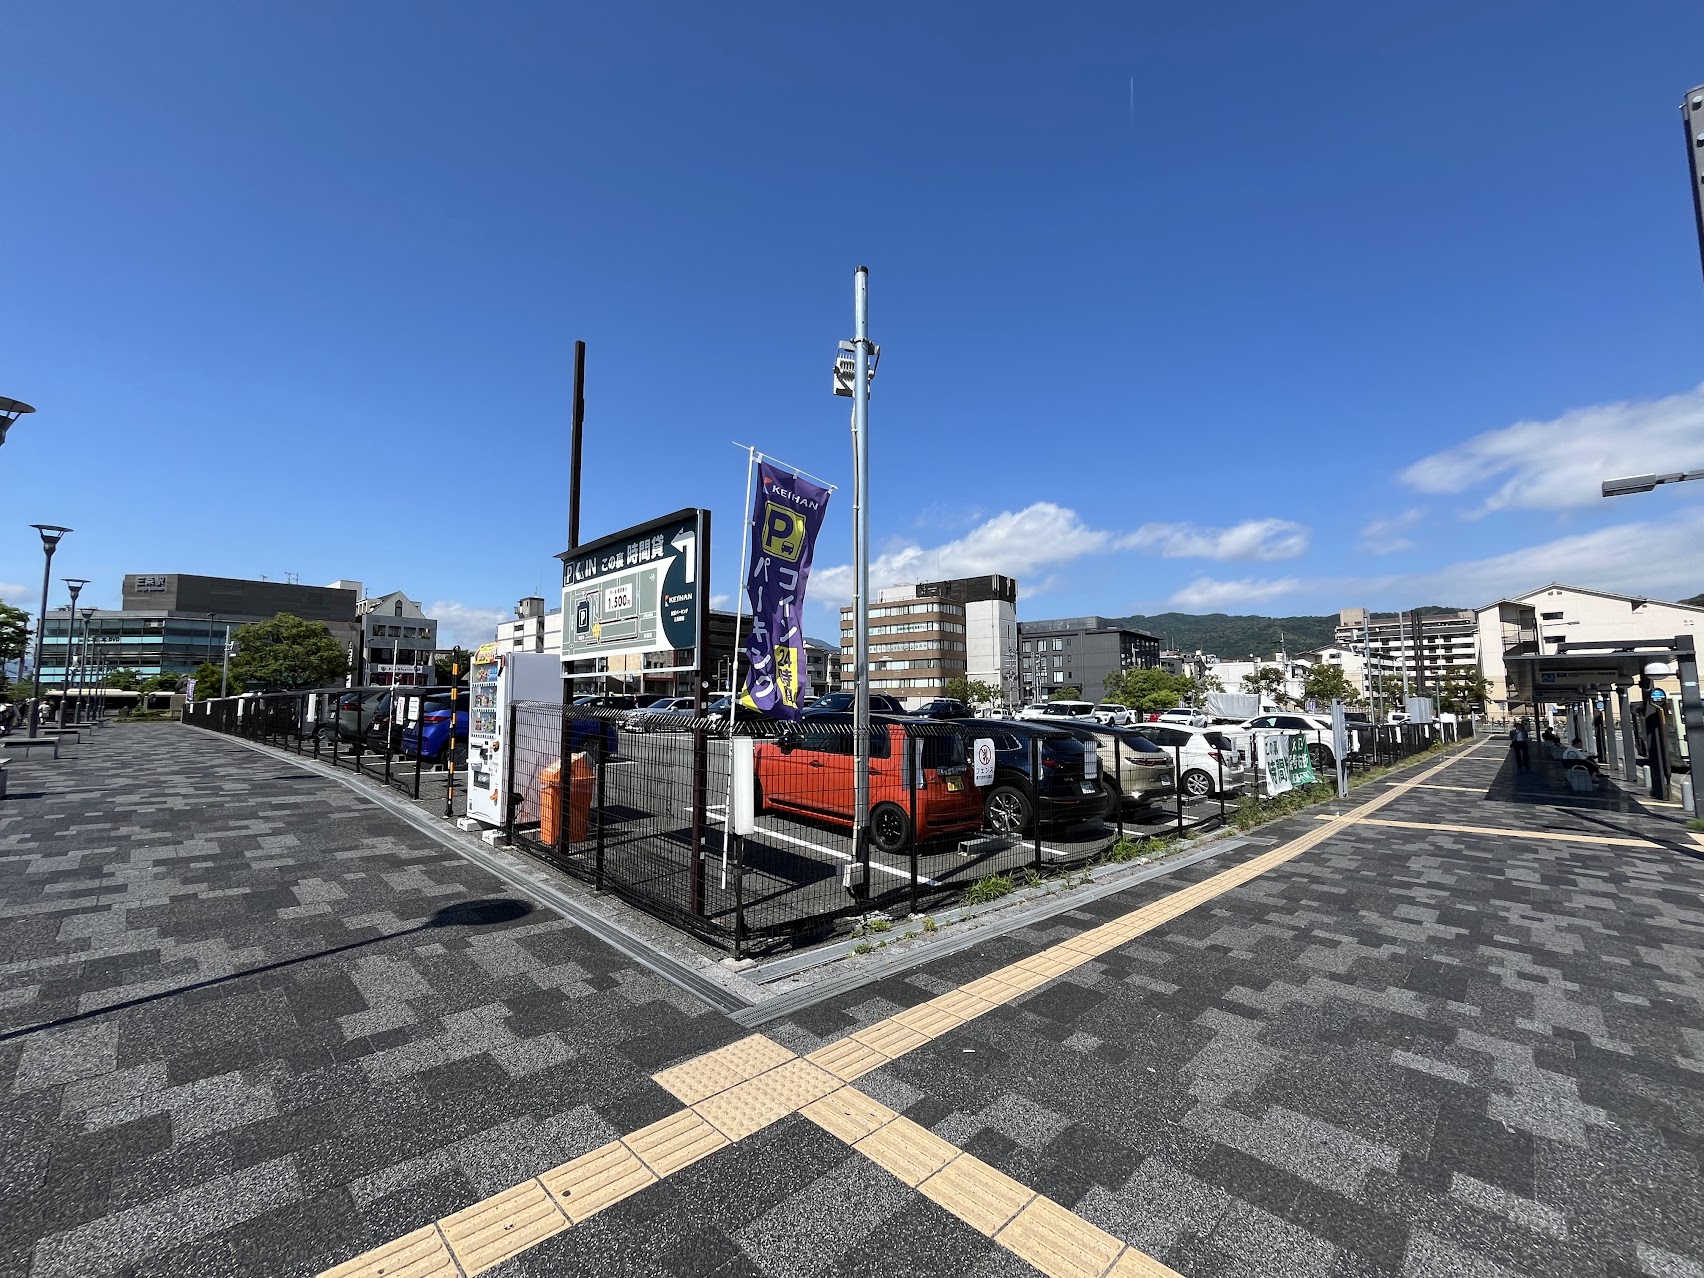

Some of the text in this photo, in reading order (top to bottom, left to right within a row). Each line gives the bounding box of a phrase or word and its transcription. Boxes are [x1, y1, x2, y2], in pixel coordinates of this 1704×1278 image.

[772, 484, 819, 510] KEIHAN
[766, 508, 794, 548] P
[601, 552, 624, 572] この裏
[627, 534, 664, 565] 時間貸
[669, 593, 693, 604] KEIHAN
[778, 566, 799, 642] コイン
[580, 610, 586, 625] P
[976, 767, 994, 775] フェンス
